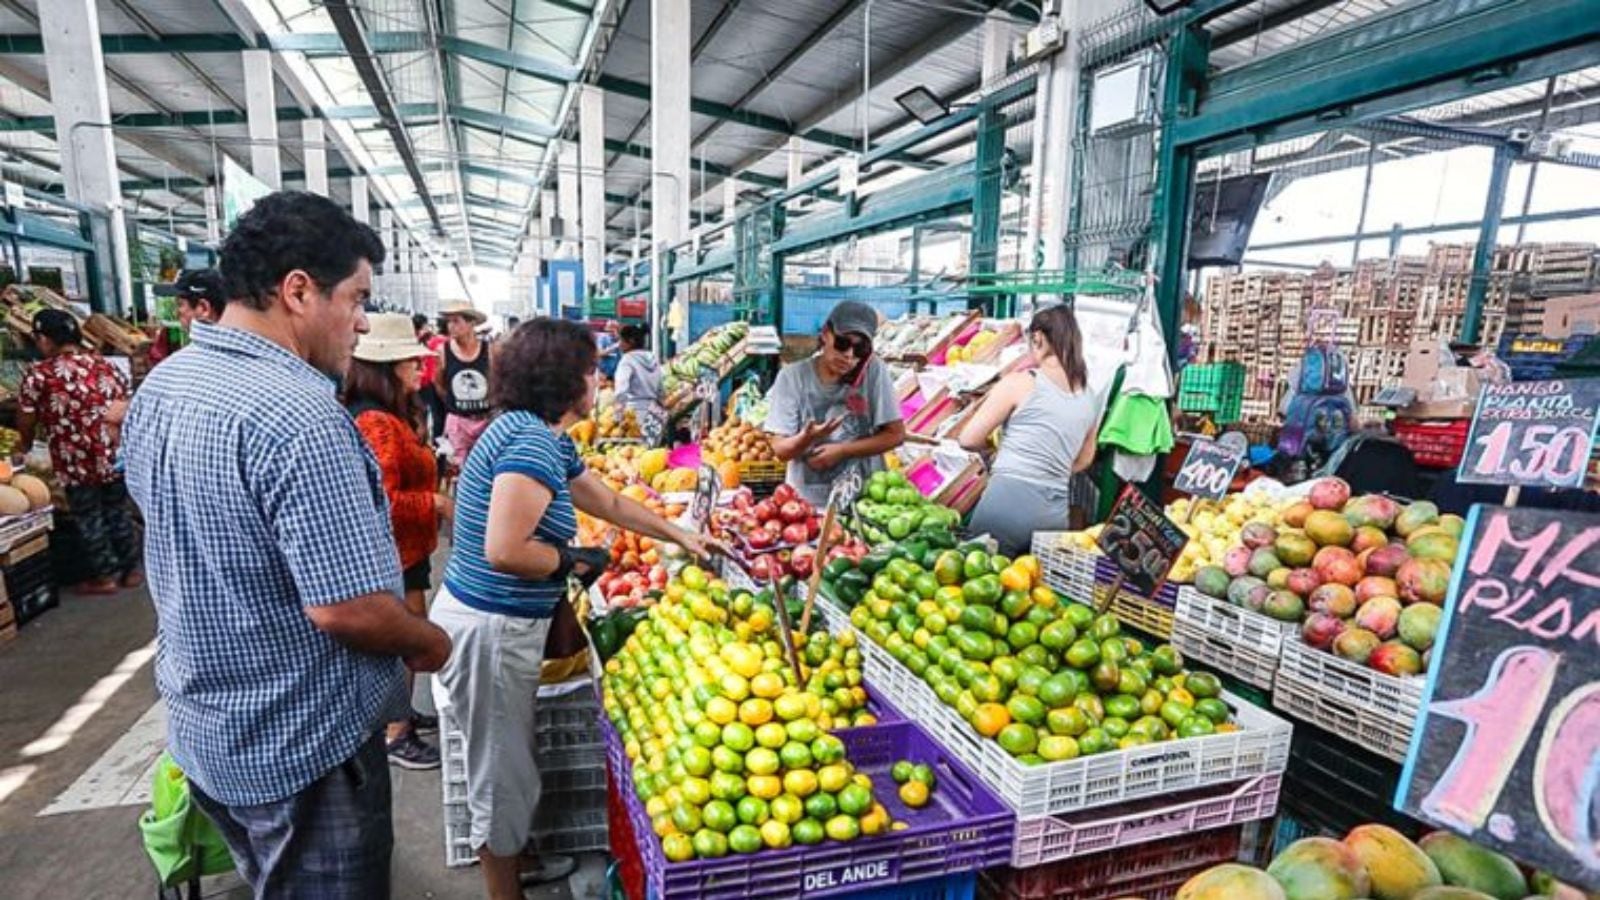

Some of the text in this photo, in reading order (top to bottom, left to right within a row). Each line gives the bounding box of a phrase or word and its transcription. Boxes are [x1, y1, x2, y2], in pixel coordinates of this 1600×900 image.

[1486, 381, 1563, 395] MANGO
[1483, 393, 1573, 409] PLANTA
[803, 860, 889, 892] DEL ANDE
